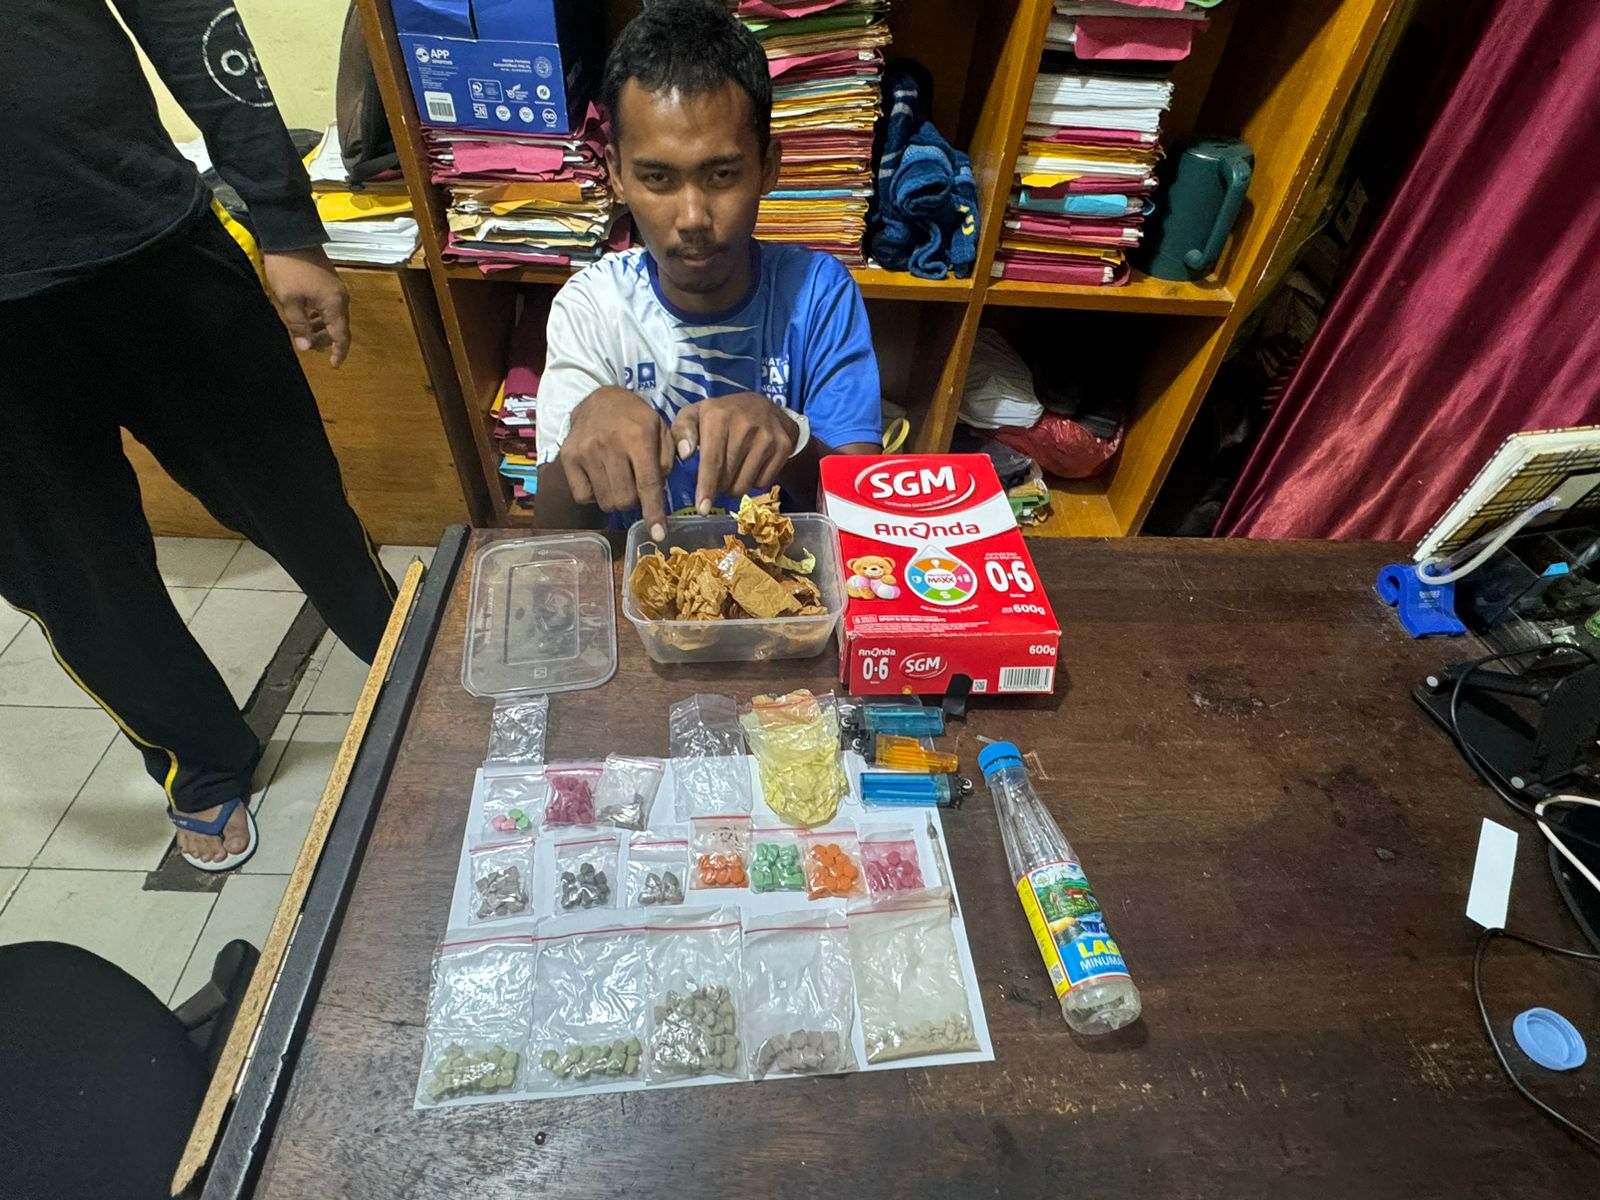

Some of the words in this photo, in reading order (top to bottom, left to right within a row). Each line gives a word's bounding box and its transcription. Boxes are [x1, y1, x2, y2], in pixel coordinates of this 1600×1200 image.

[431, 49, 450, 59] APP
[637, 381, 656, 390] PAN
[869, 466, 957, 500] SGM
[1012, 604, 1046, 616] 600g
[1029, 645, 1056, 656] 600g
[905, 656, 941, 674] SGM
